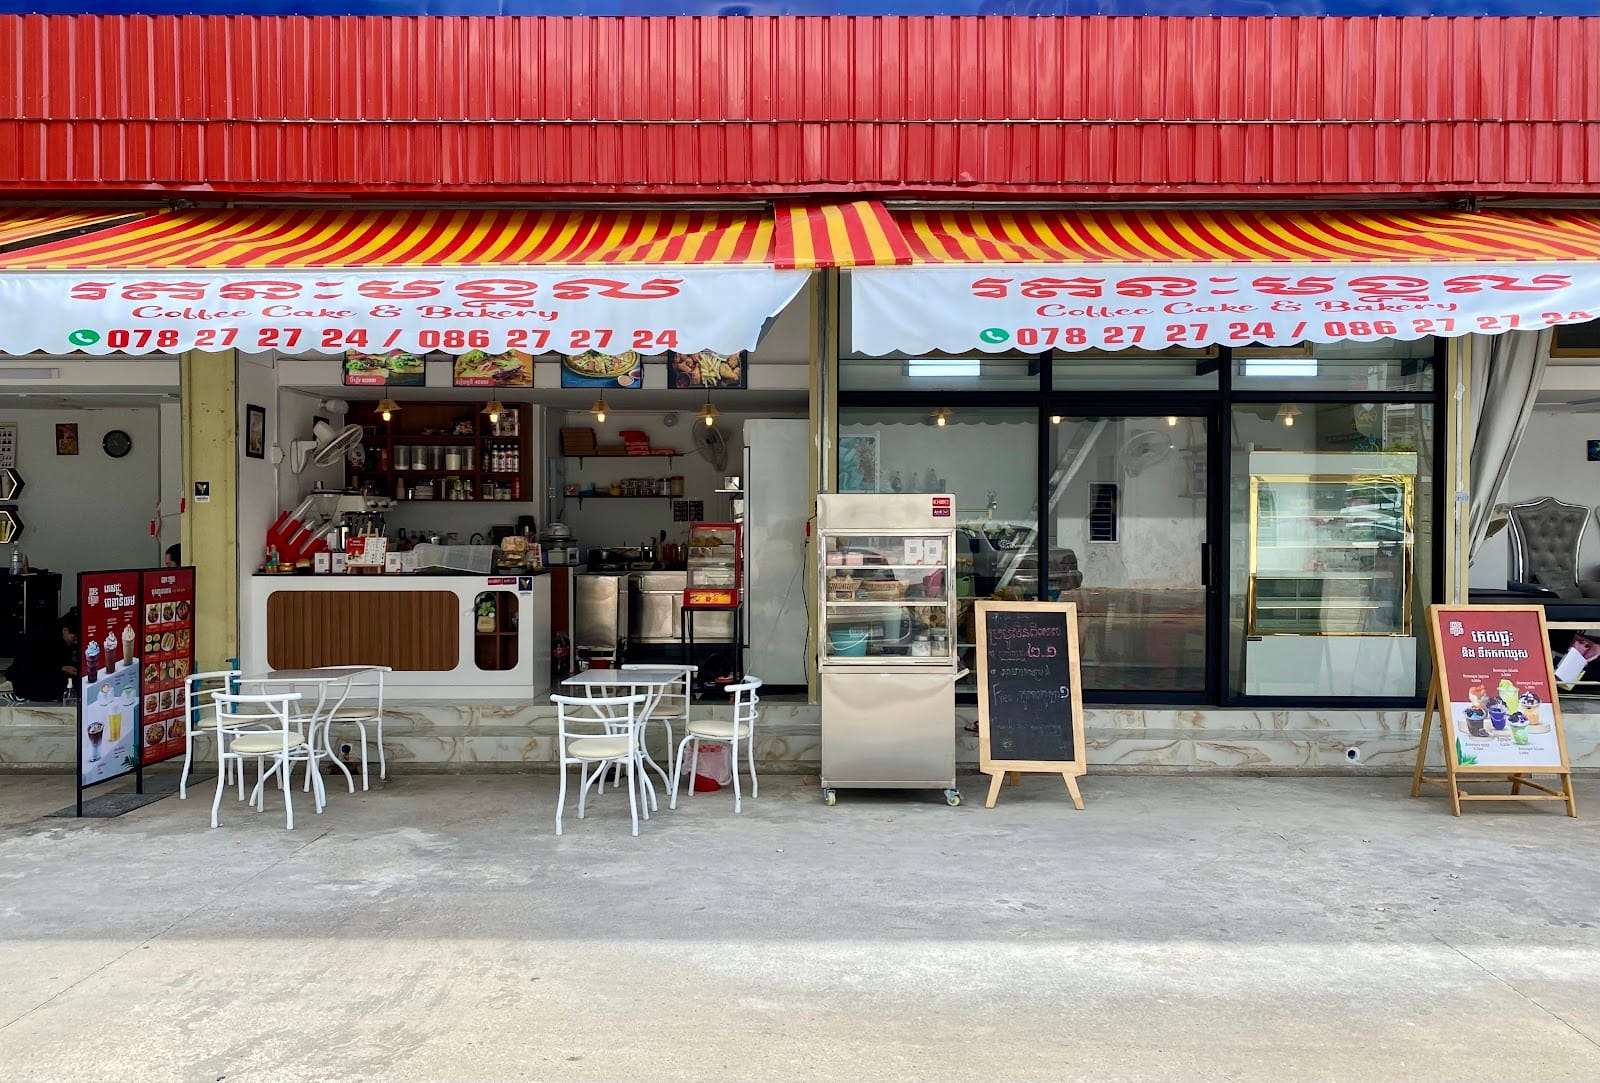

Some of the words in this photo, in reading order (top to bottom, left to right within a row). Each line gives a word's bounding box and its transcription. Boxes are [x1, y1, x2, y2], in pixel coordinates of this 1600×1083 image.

[132, 305, 253, 320] Coffee
[261, 305, 358, 319] Cake
[369, 305, 403, 318] &
[416, 304, 559, 322] Bakery
[1036, 303, 1155, 318] Coffee
[1163, 301, 1259, 315] Cake
[1270, 300, 1302, 313] &
[1315, 300, 1457, 313] Bakery
[107, 329, 179, 348] 078
[194, 327, 239, 346] 27
[257, 328, 303, 347] 27
[322, 328, 368, 347] 24
[382, 329, 403, 347] /
[418, 329, 489, 348] 086
[506, 329, 551, 348] 27
[570, 329, 613, 348] 27
[632, 329, 678, 348] 24
[1016, 327, 1087, 345] 078
[1103, 325, 1146, 344] 27
[1166, 323, 1209, 341] 27
[1229, 322, 1275, 340] 24
[1291, 321, 1307, 338] /
[1323, 320, 1398, 337] 086
[1412, 318, 1456, 333] 27
[1476, 314, 1520, 330] 27
